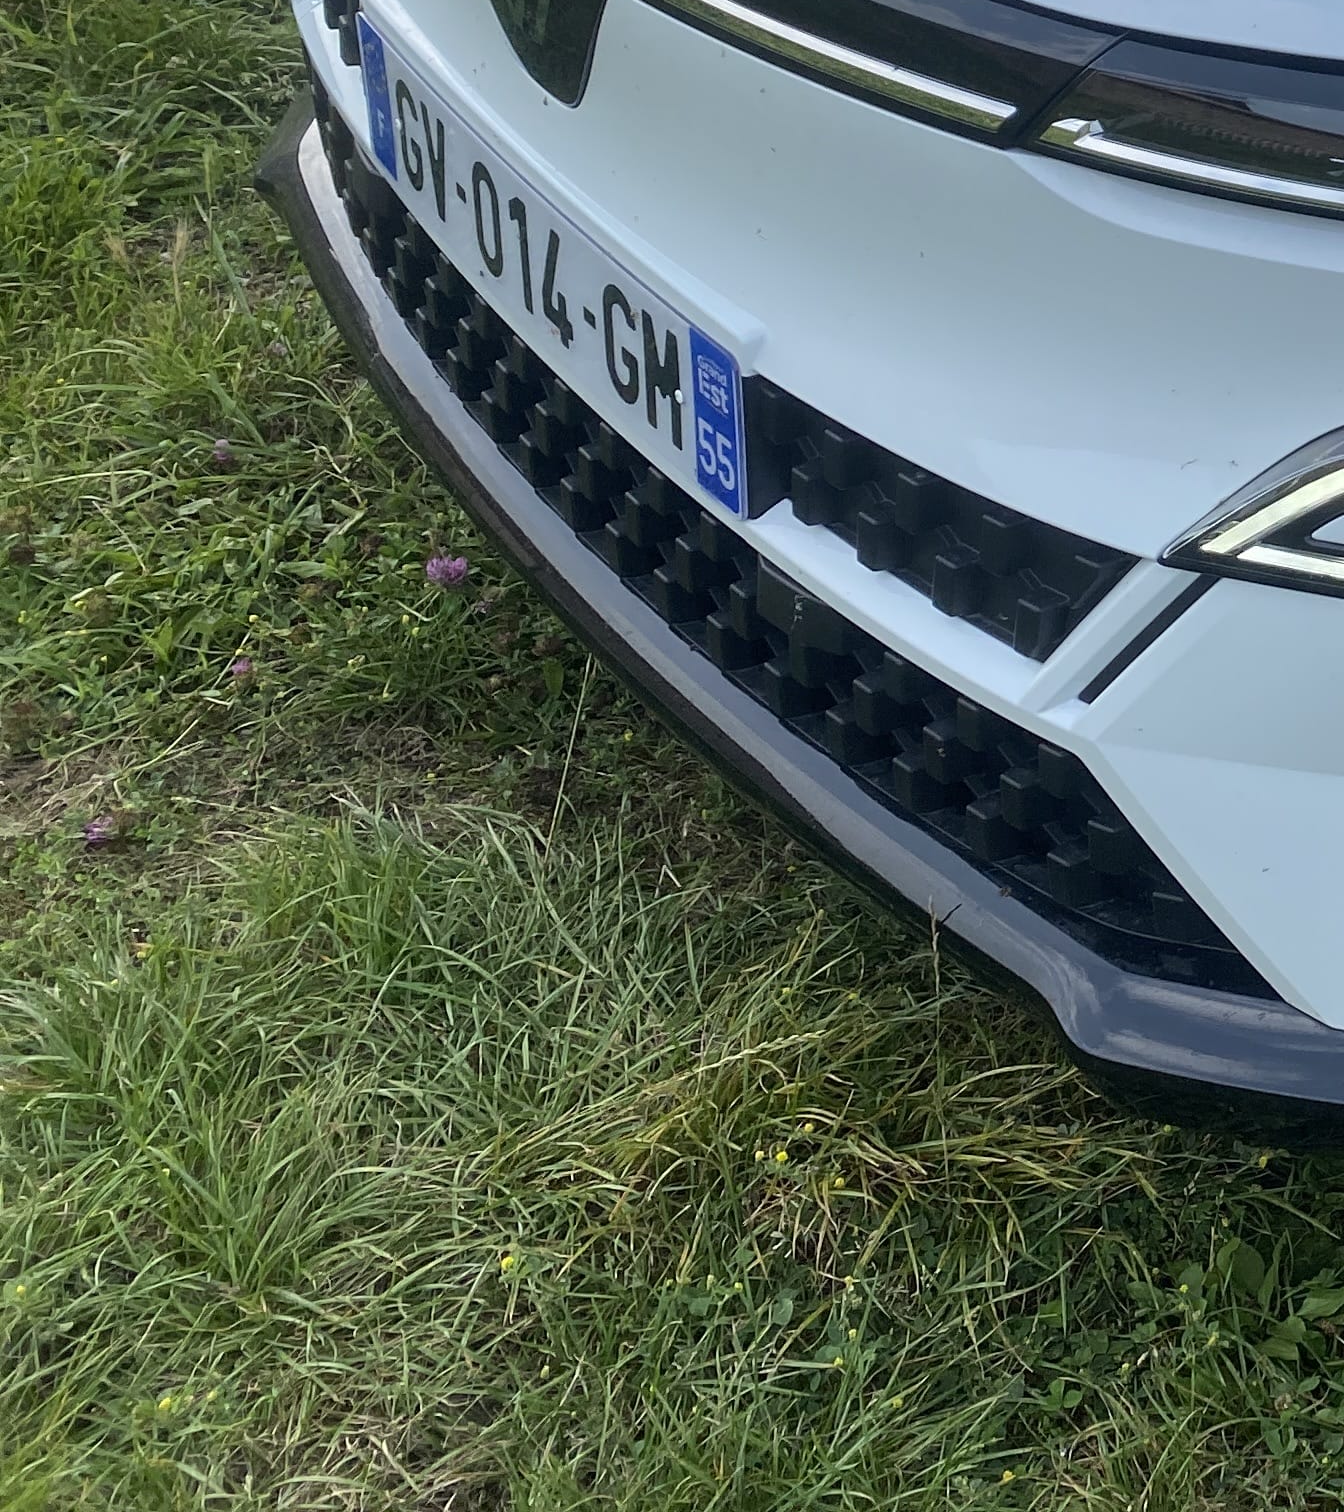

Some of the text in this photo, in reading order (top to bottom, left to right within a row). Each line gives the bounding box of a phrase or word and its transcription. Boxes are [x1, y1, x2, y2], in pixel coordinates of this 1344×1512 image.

[376, 107, 386, 138] F
[395, 79, 683, 451] GV-014-GM
[697, 354, 728, 388] Grand
[698, 367, 730, 414] Est
[698, 417, 736, 491] 55
